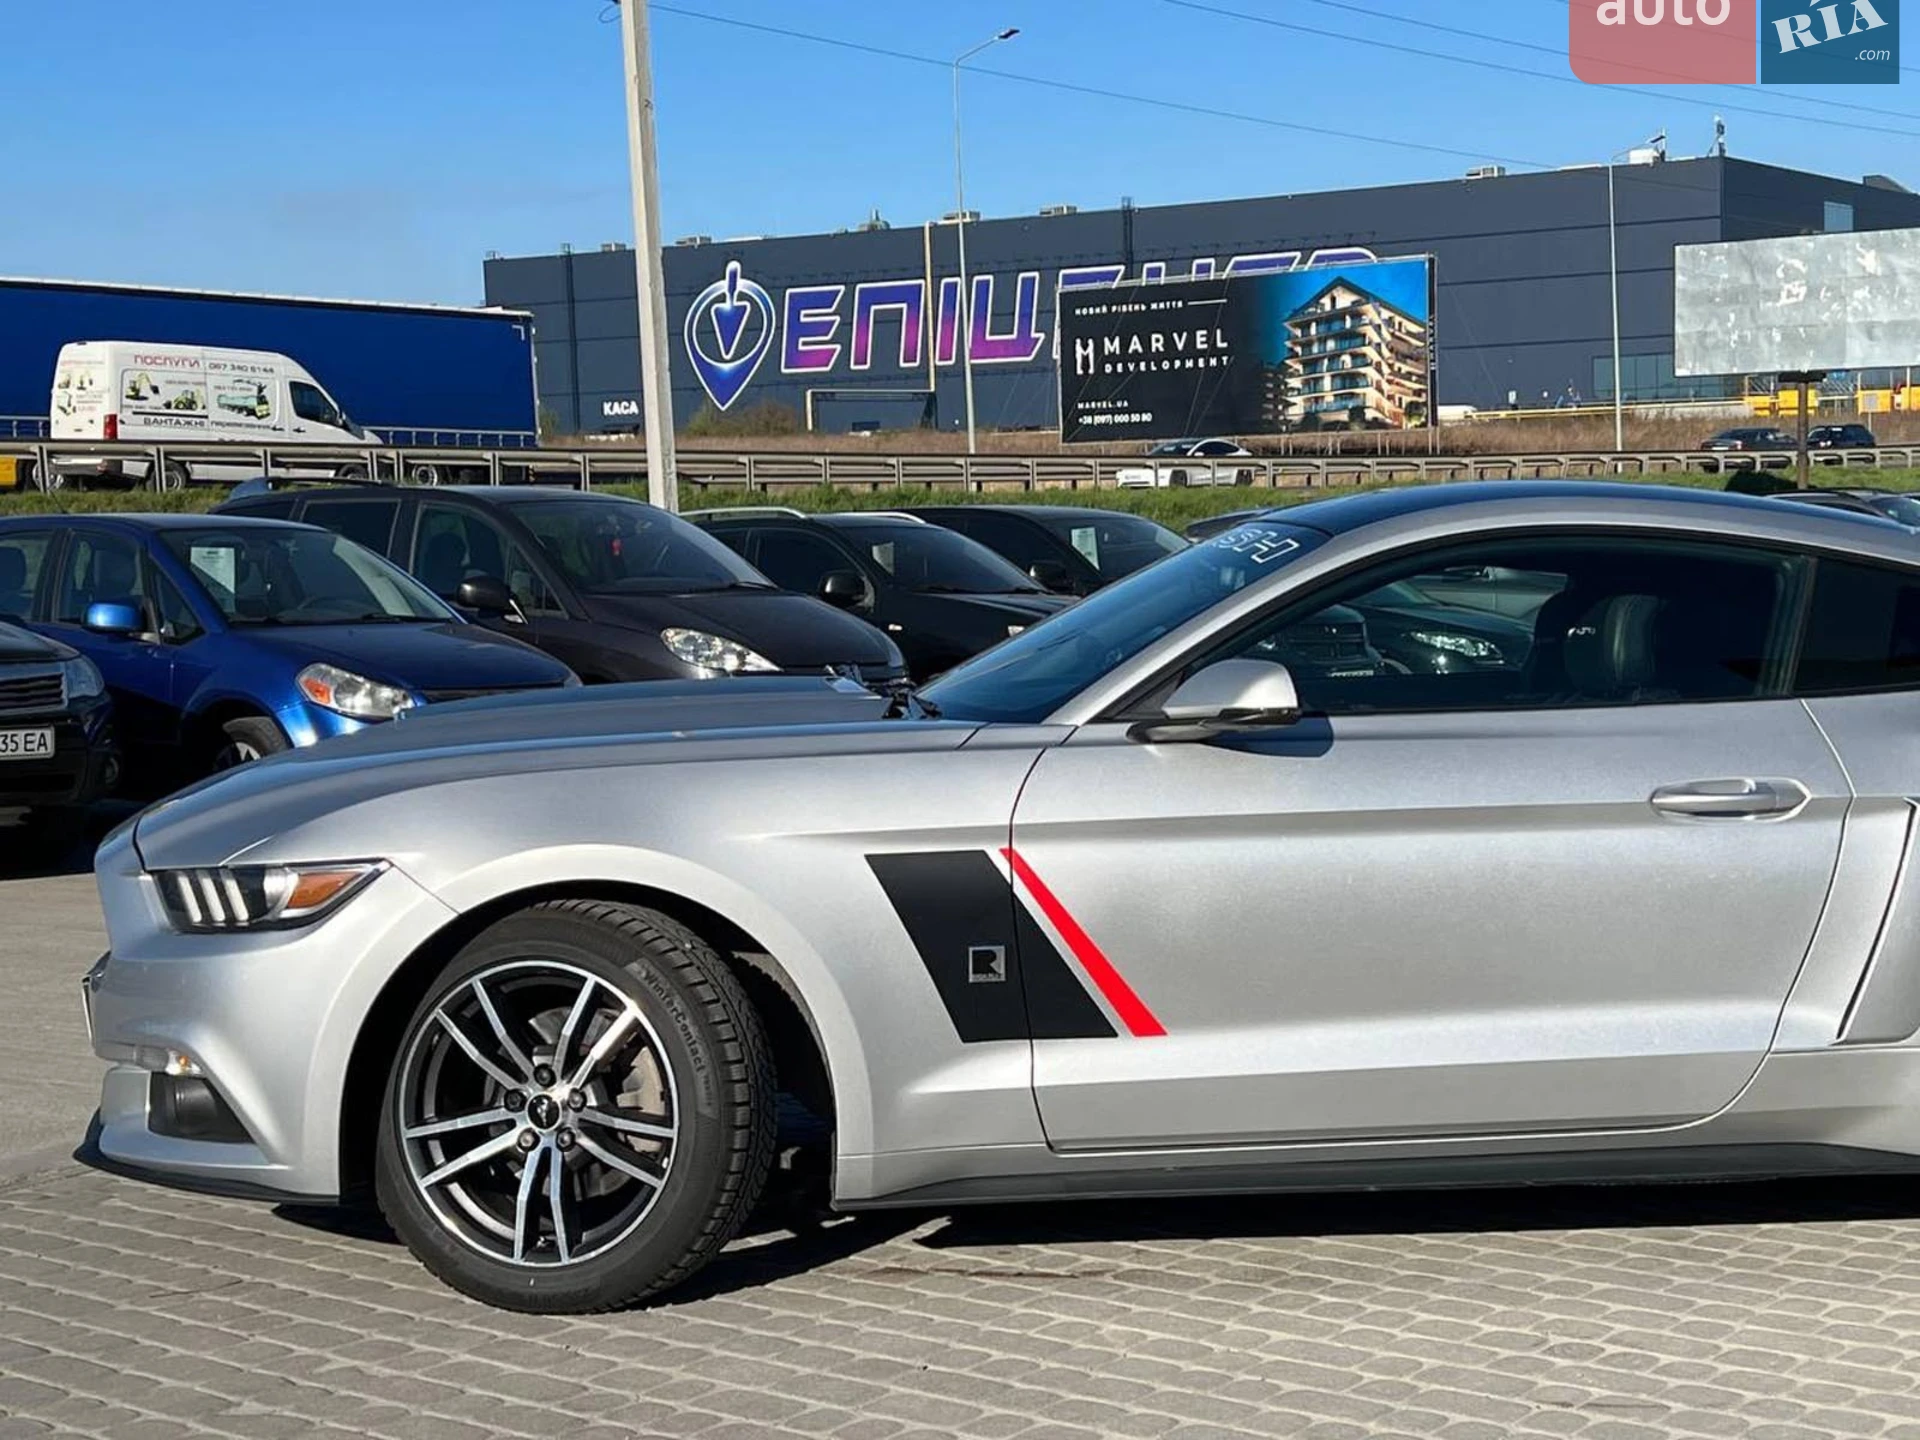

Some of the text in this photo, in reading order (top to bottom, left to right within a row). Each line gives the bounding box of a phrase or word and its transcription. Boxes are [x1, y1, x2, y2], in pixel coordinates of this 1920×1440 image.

[1075, 304, 1108, 316] НОВИЙ
[1111, 303, 1146, 313] РІВЕНЬ
[1104, 328, 1229, 356] MARVEL
[1104, 356, 1230, 374] DEVELOPMENT
[603, 400, 640, 416] КАСА
[23, 732, 48, 752] EA
